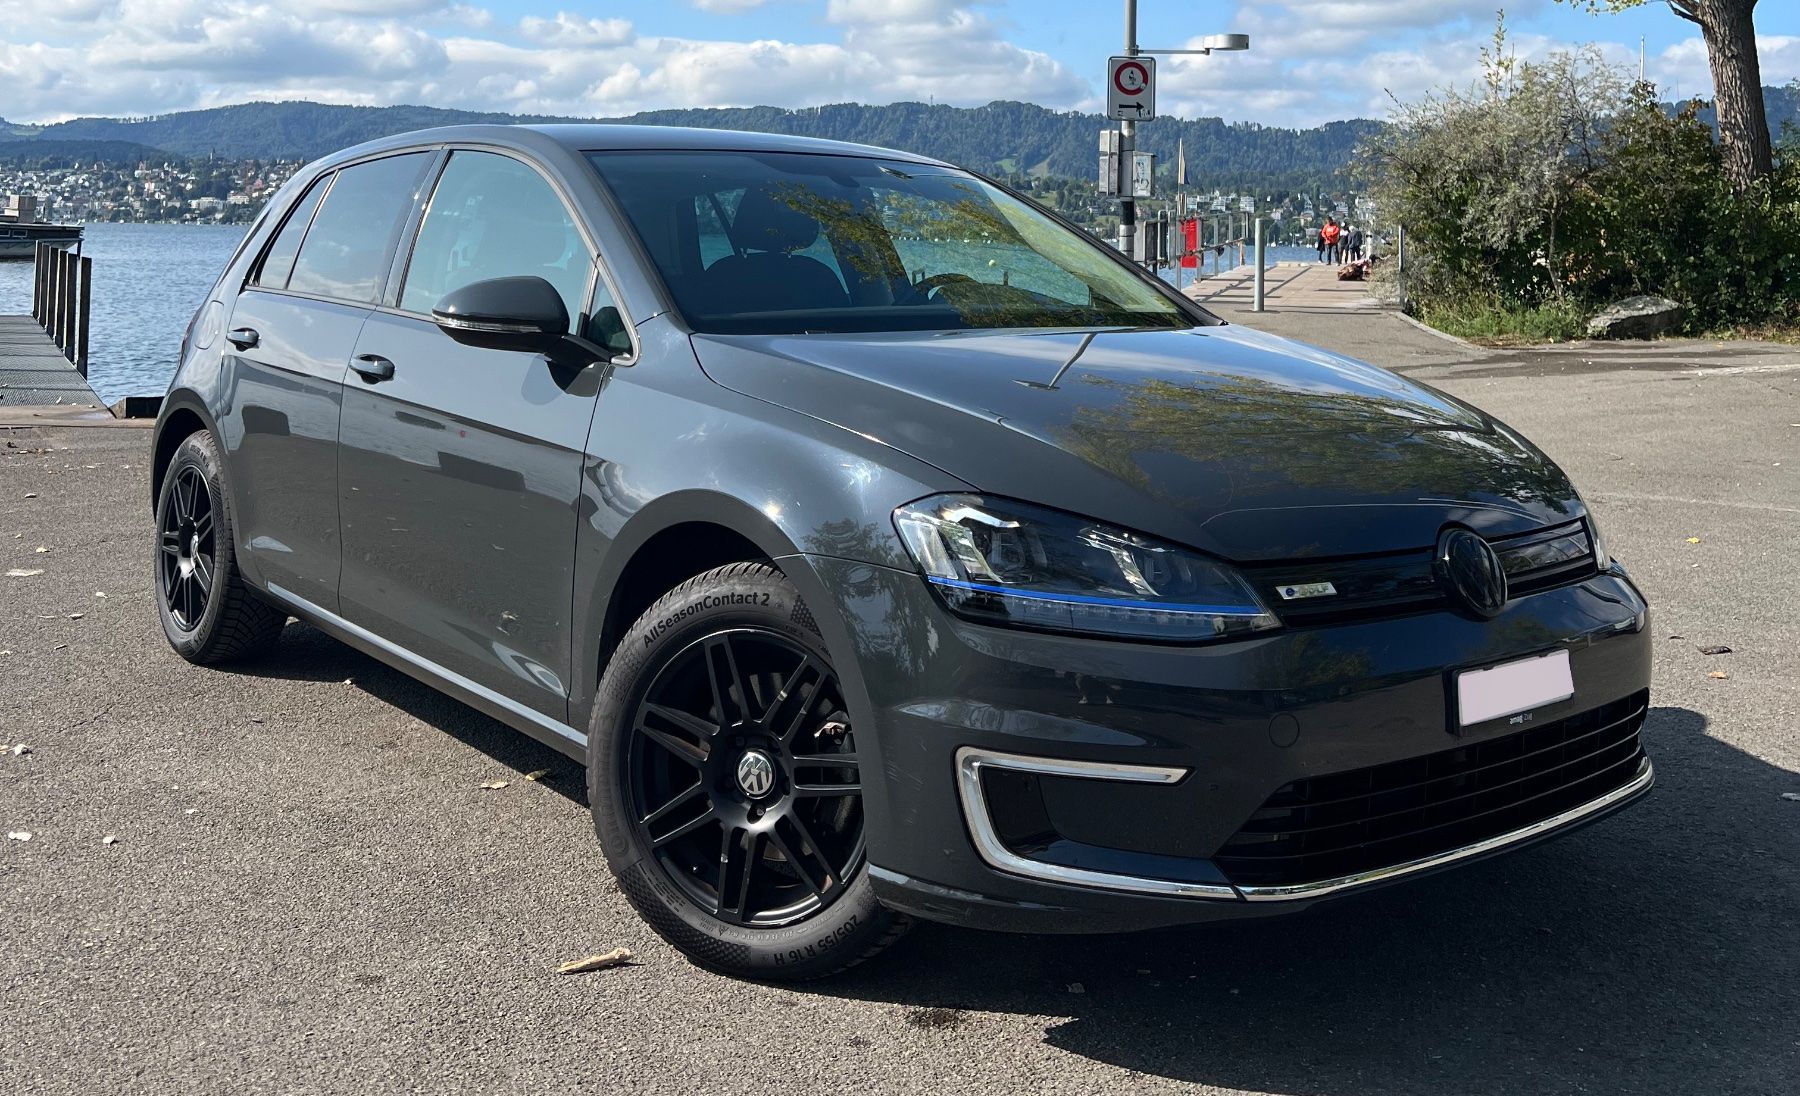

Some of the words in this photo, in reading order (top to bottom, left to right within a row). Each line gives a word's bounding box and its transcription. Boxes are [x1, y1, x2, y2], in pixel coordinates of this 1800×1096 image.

[642, 592, 759, 648] AllSeasonContact
[760, 592, 770, 607] 2
[817, 914, 863, 950] 205/55
[788, 948, 805, 963] 16
[805, 944, 817, 957] R
[773, 952, 786, 966] H
